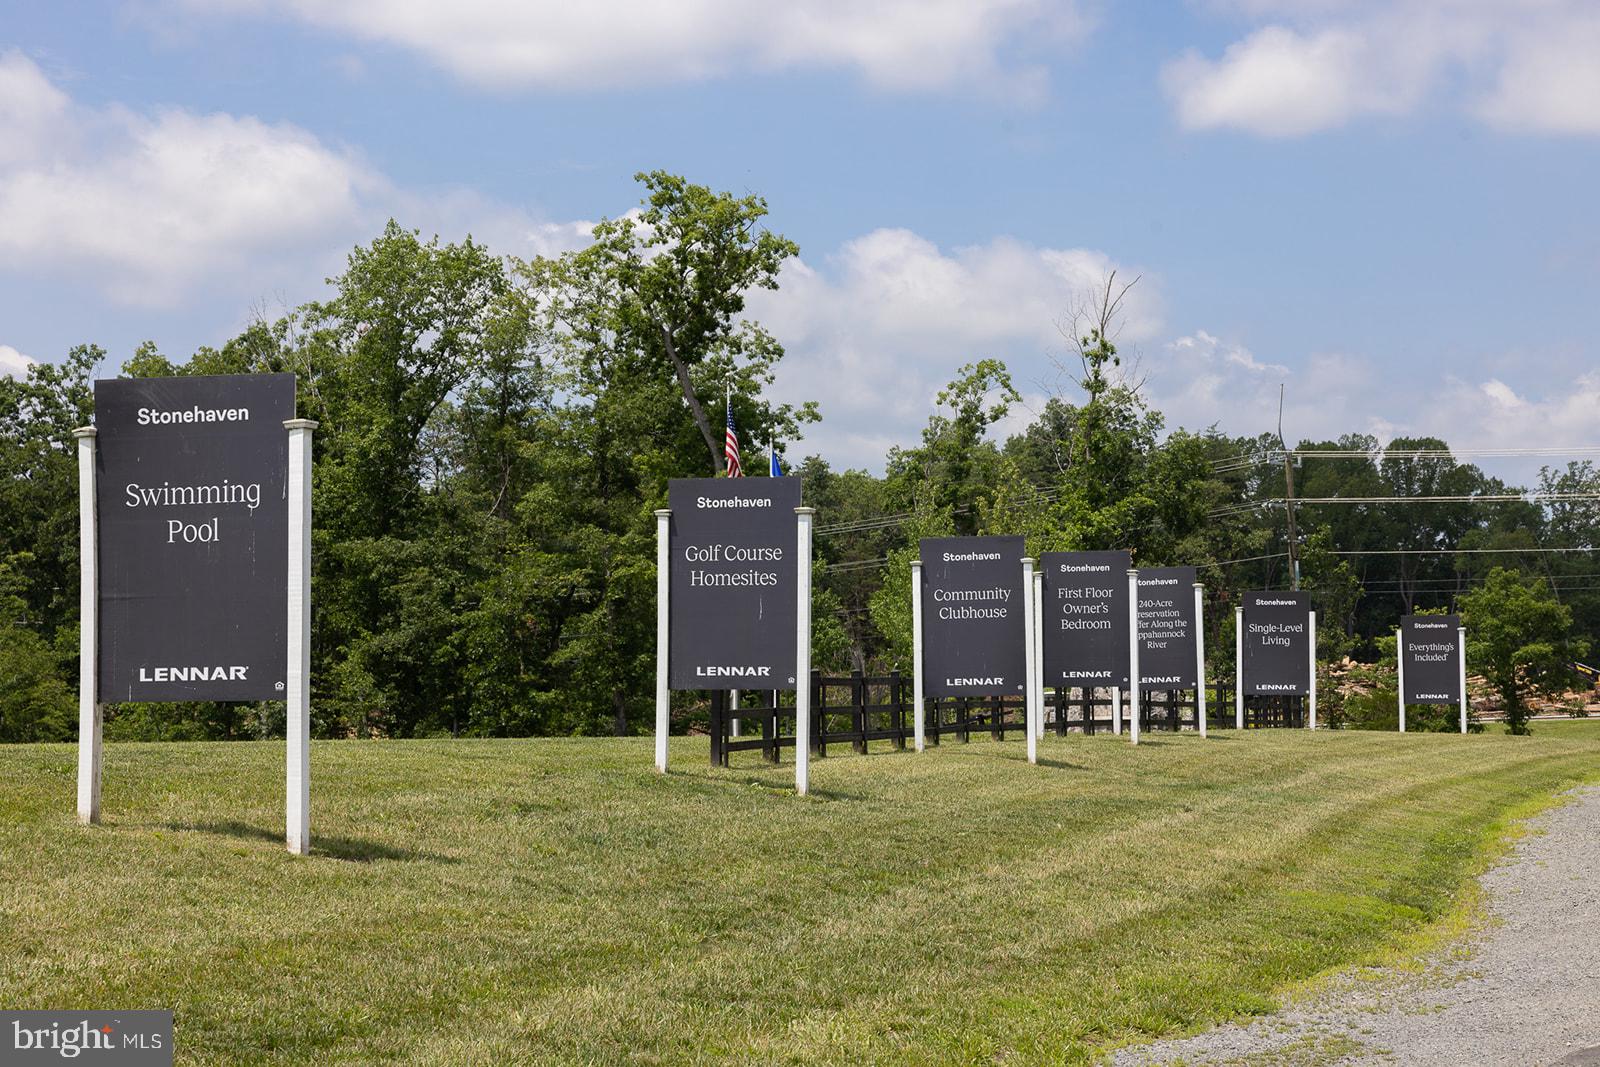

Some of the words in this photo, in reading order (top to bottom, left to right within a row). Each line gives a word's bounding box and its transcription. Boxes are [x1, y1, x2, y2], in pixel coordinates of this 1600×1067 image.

[137, 406, 249, 425] Stonehaven
[125, 480, 261, 508] Swimming
[697, 496, 771, 508] Stonehaven
[167, 518, 220, 543] Pool
[685, 545, 722, 562] Golf
[724, 545, 783, 561] Course
[943, 552, 1000, 561] Stonehaven
[1060, 564, 1110, 573] Stonehaven
[690, 570, 777, 586] Homesites
[1137, 578, 1178, 586] tonehaven
[934, 587, 1011, 602] Community
[1058, 587, 1082, 598] First
[1085, 587, 1113, 598] Floor
[1139, 599, 1173, 608] 240-Acre
[1255, 598, 1297, 606] Stonehaven
[939, 607, 1007, 619] Clubhouse
[1063, 602, 1109, 614] Owner's
[1137, 609, 1180, 618] reservation
[1061, 618, 1111, 629] Bedroom
[1151, 619, 1174, 630] Along
[1174, 619, 1188, 627] the
[1248, 623, 1303, 634] Single-Level
[1137, 629, 1186, 641] ppahannock
[1147, 640, 1168, 649] River
[1262, 635, 1290, 647] Living
[1409, 643, 1454, 653] Everything's
[139, 666, 249, 682] LENNAR
[696, 666, 771, 677] LENNAR
[946, 677, 1004, 686] LENNAR
[1139, 676, 1181, 684] ENNAR
